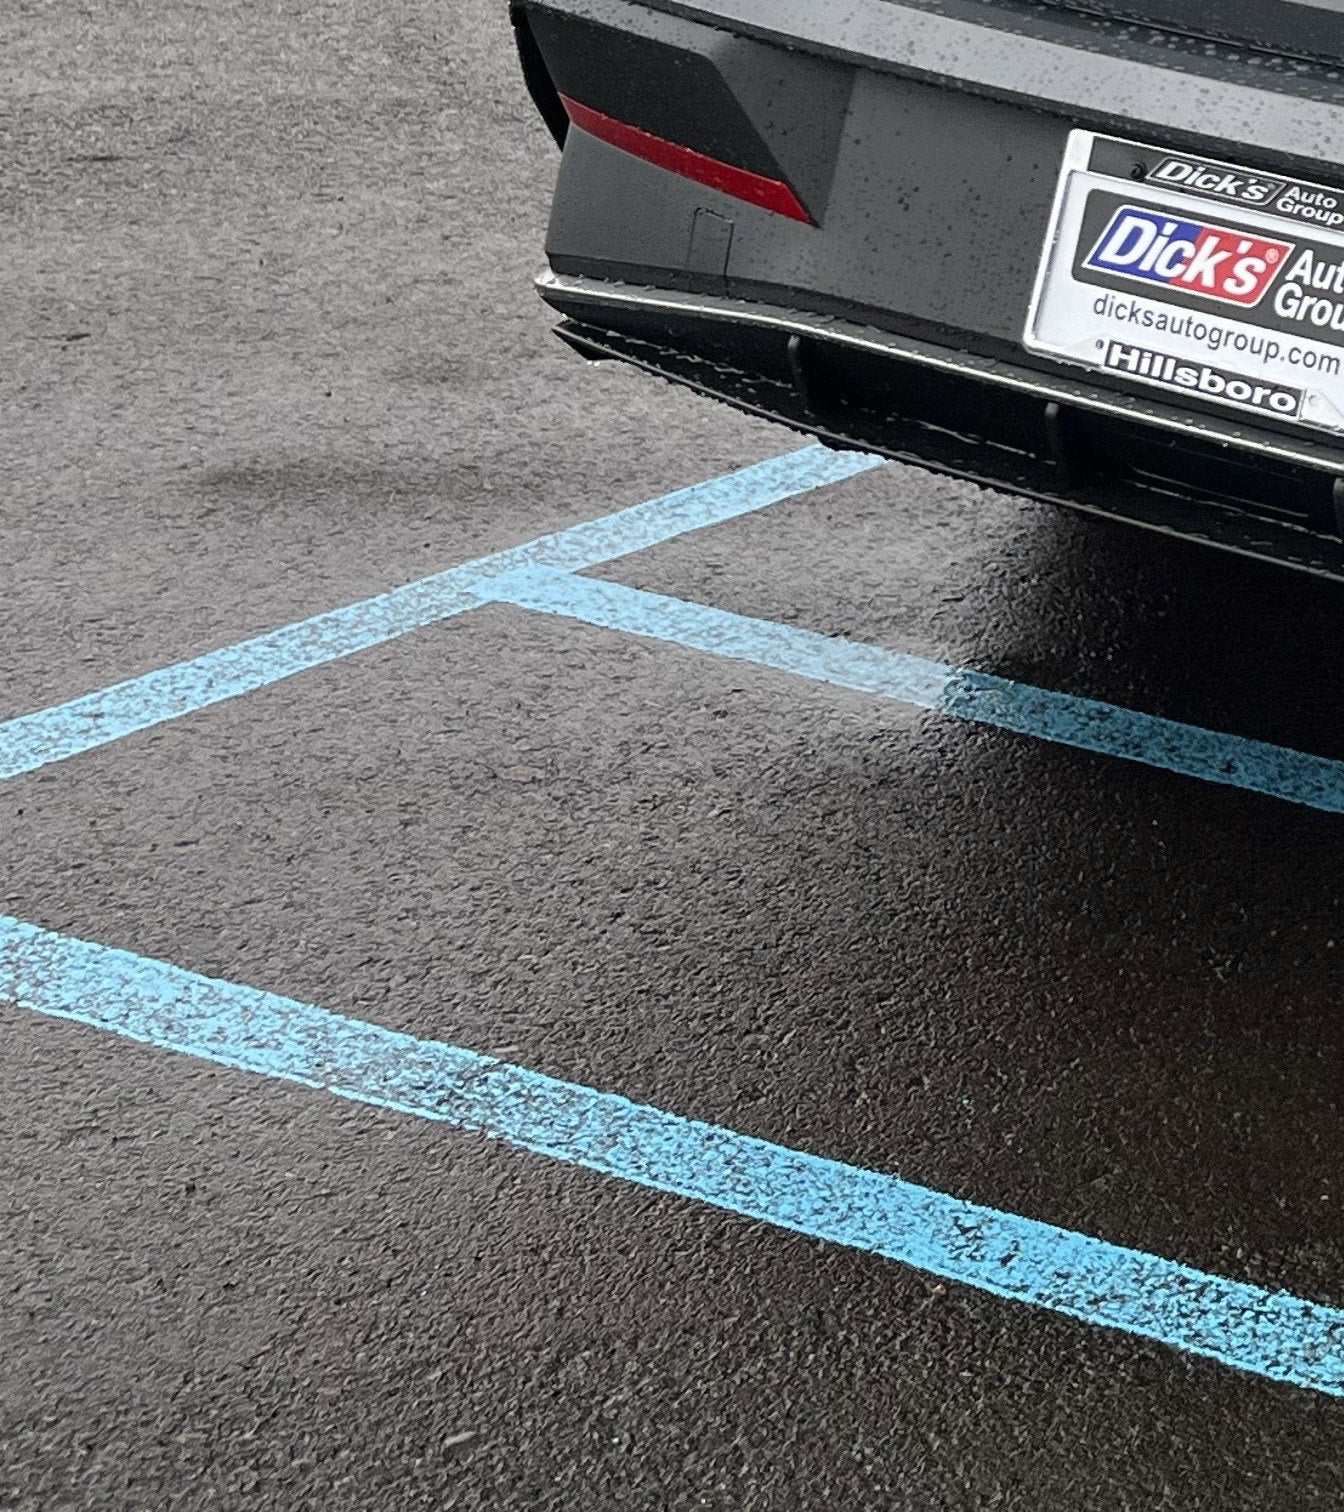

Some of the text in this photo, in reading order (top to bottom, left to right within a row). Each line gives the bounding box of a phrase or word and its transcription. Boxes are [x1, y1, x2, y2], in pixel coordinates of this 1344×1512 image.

[1276, 198, 1344, 226] Group
[1284, 186, 1339, 209] Auto
[1092, 293, 1342, 376] dicksautogroup.com
[1107, 342, 1297, 413] Hillsboro
